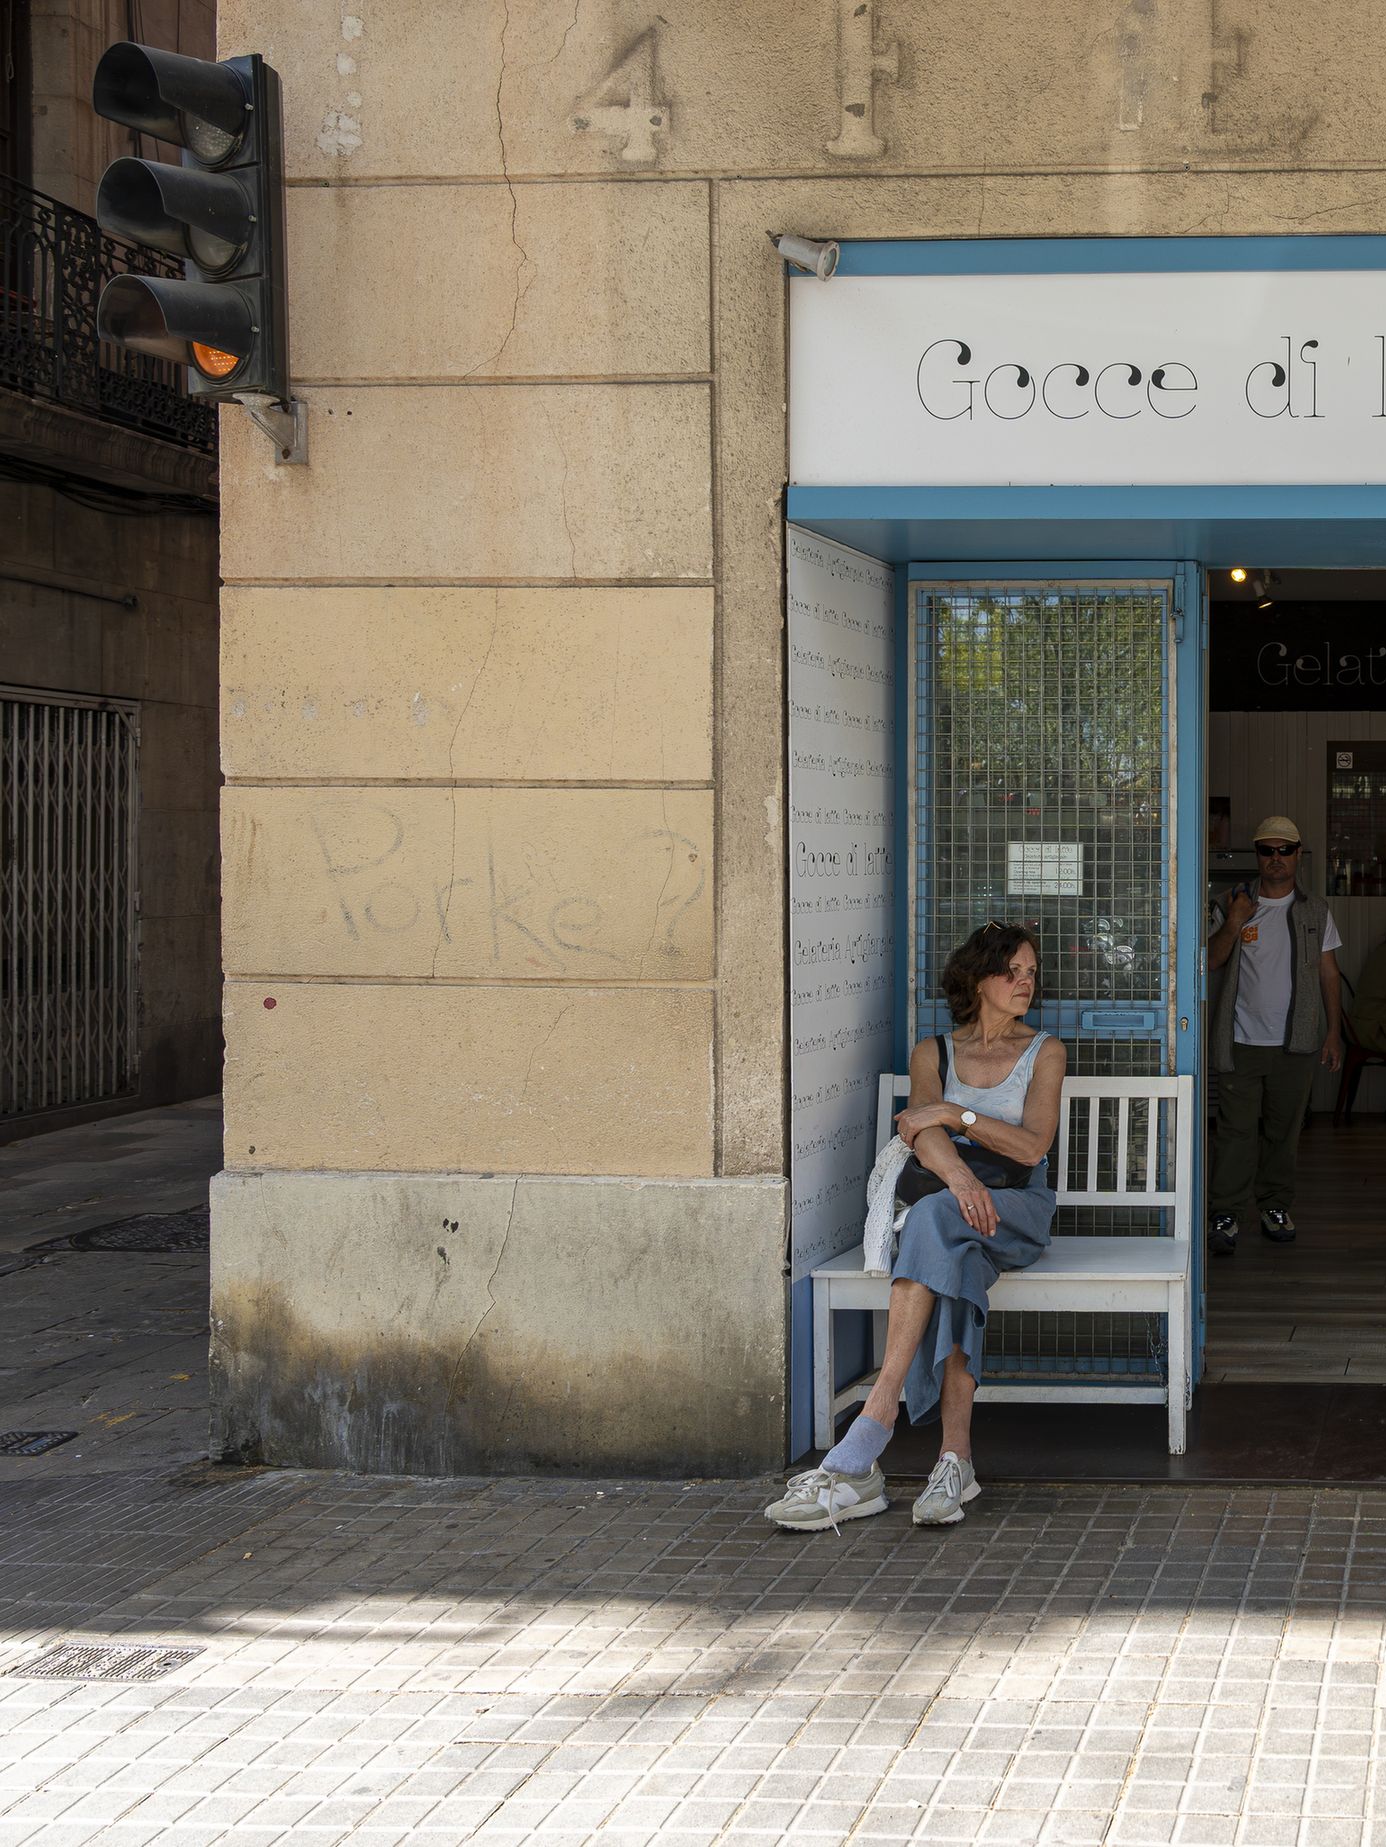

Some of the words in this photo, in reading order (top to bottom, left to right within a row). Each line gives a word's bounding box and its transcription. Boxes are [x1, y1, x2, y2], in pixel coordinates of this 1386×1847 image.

[915, 337, 1199, 422] Gocce
[1245, 335, 1327, 419] di
[308, 799, 707, 973] Porke?
[796, 840, 840, 877] Gocce
[846, 842, 858, 875] di
[863, 842, 892, 875] latte
